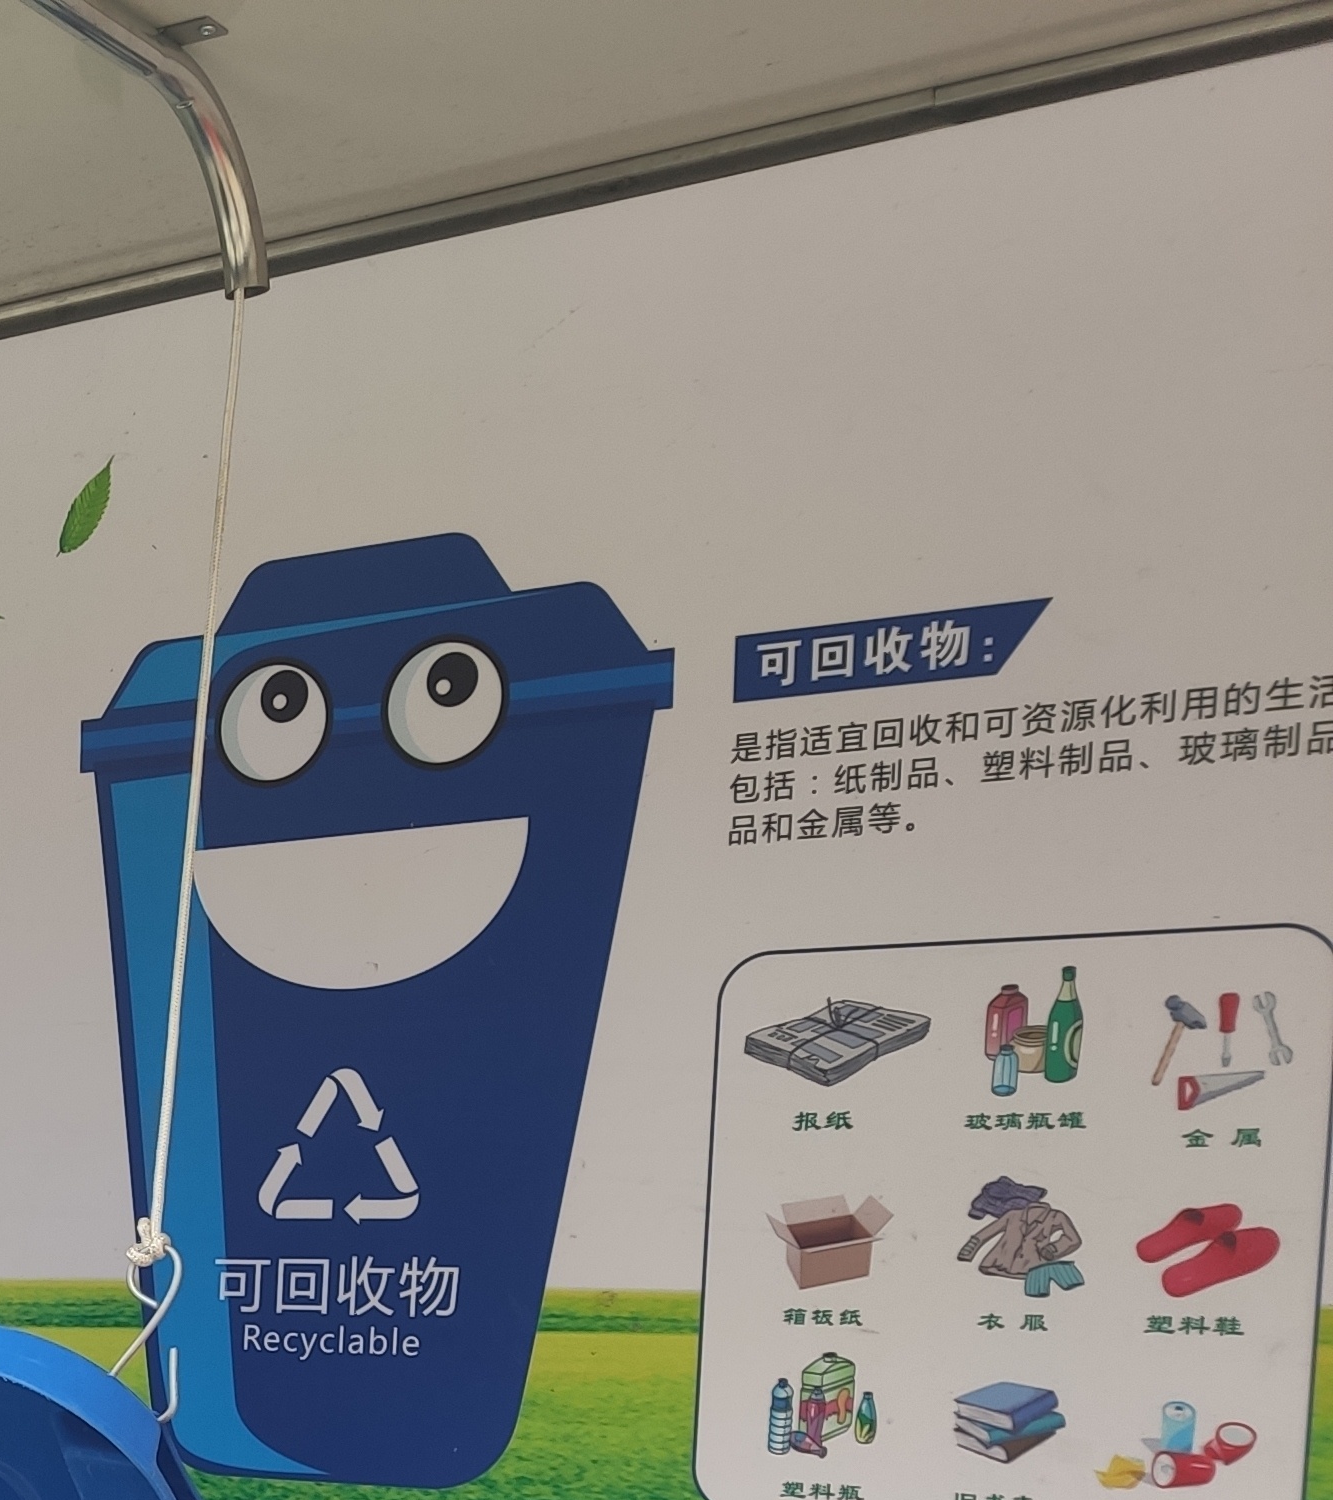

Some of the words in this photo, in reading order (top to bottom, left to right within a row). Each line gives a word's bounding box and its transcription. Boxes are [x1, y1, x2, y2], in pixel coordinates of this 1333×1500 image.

[727, 801, 916, 847] 品和金属等。
[791, 1110, 854, 1132] 报纸
[964, 1110, 1088, 1131] 玻璃瓶罐
[1180, 1126, 1263, 1149] 金属
[214, 1255, 460, 1318] 可回收物
[781, 1306, 864, 1328] 箱板纸
[976, 1312, 1050, 1333] 衣服
[1142, 1314, 1245, 1338] 塑料鞋
[242, 1323, 421, 1361] Recyclable
